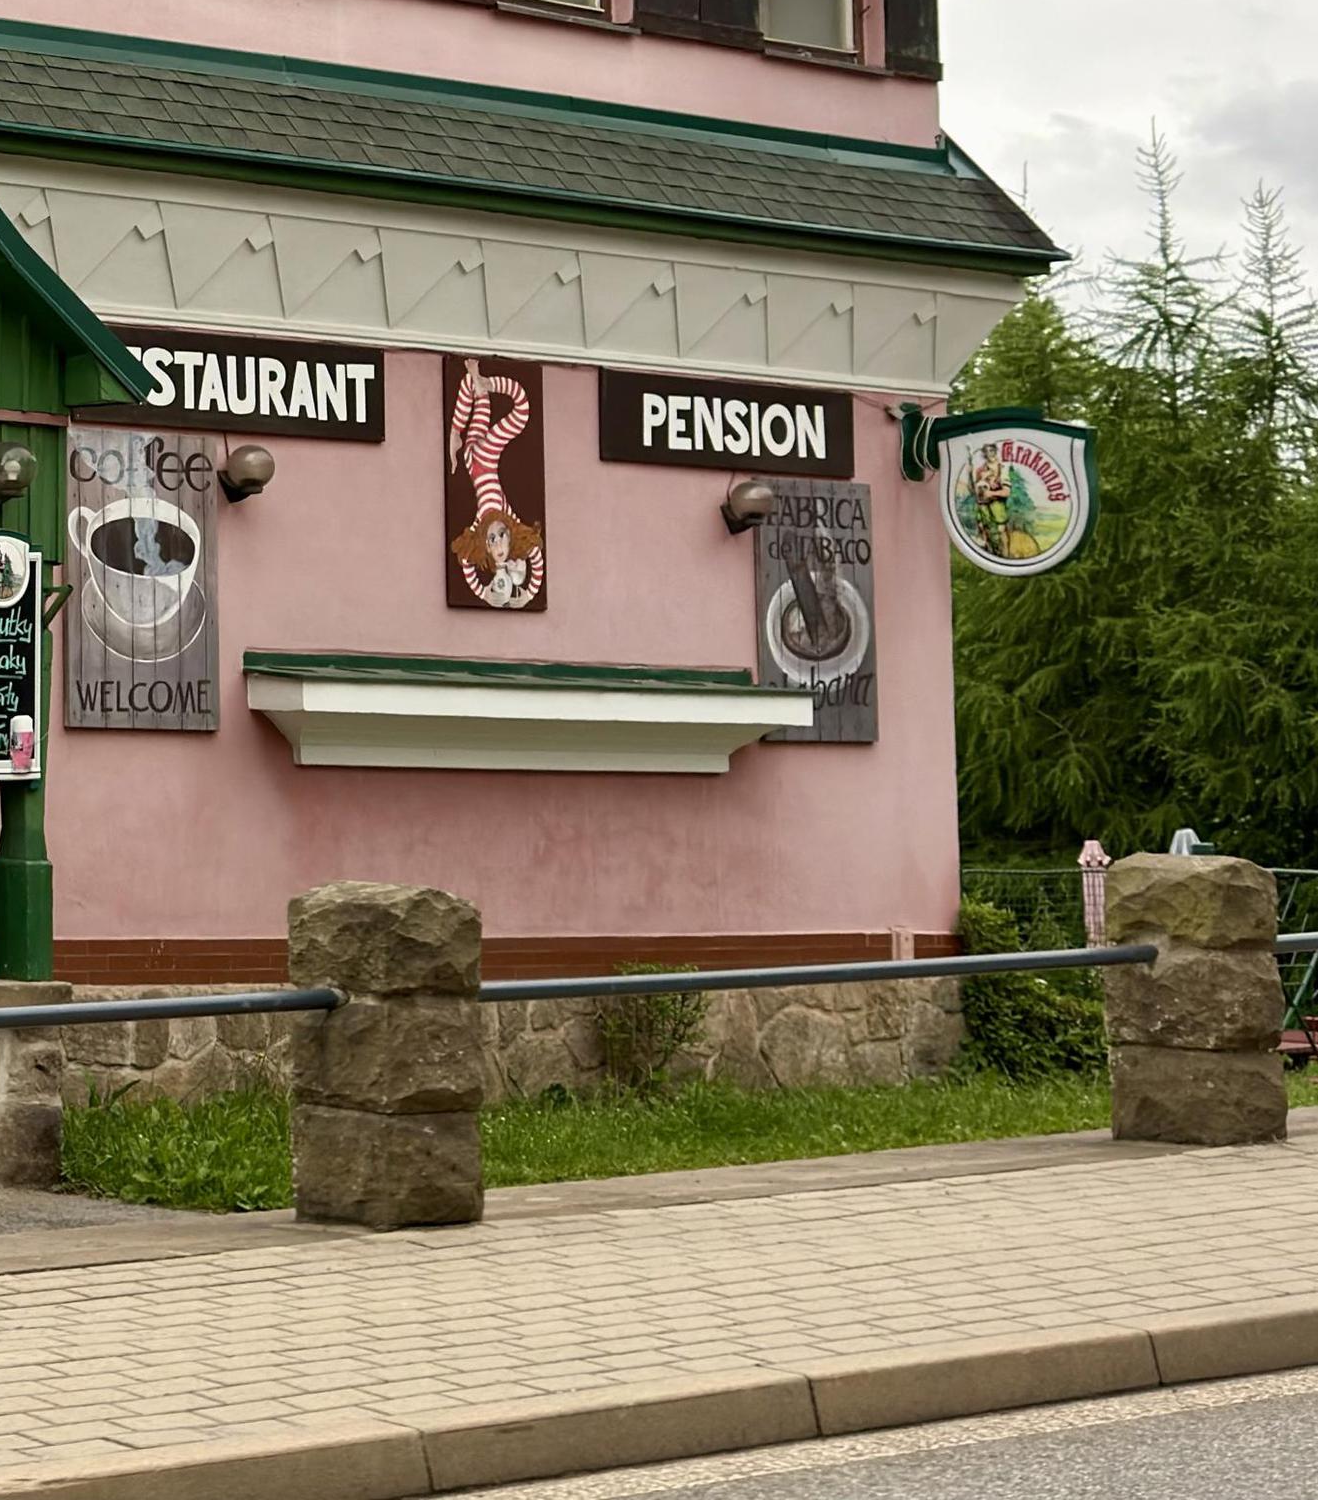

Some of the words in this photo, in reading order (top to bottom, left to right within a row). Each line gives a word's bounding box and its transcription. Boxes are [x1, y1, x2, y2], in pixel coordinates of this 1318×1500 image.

[126, 346, 375, 423] STAURANT
[643, 393, 827, 459] PENSION
[794, 536, 871, 565] TABACO
[76, 679, 212, 714] WELCOME
